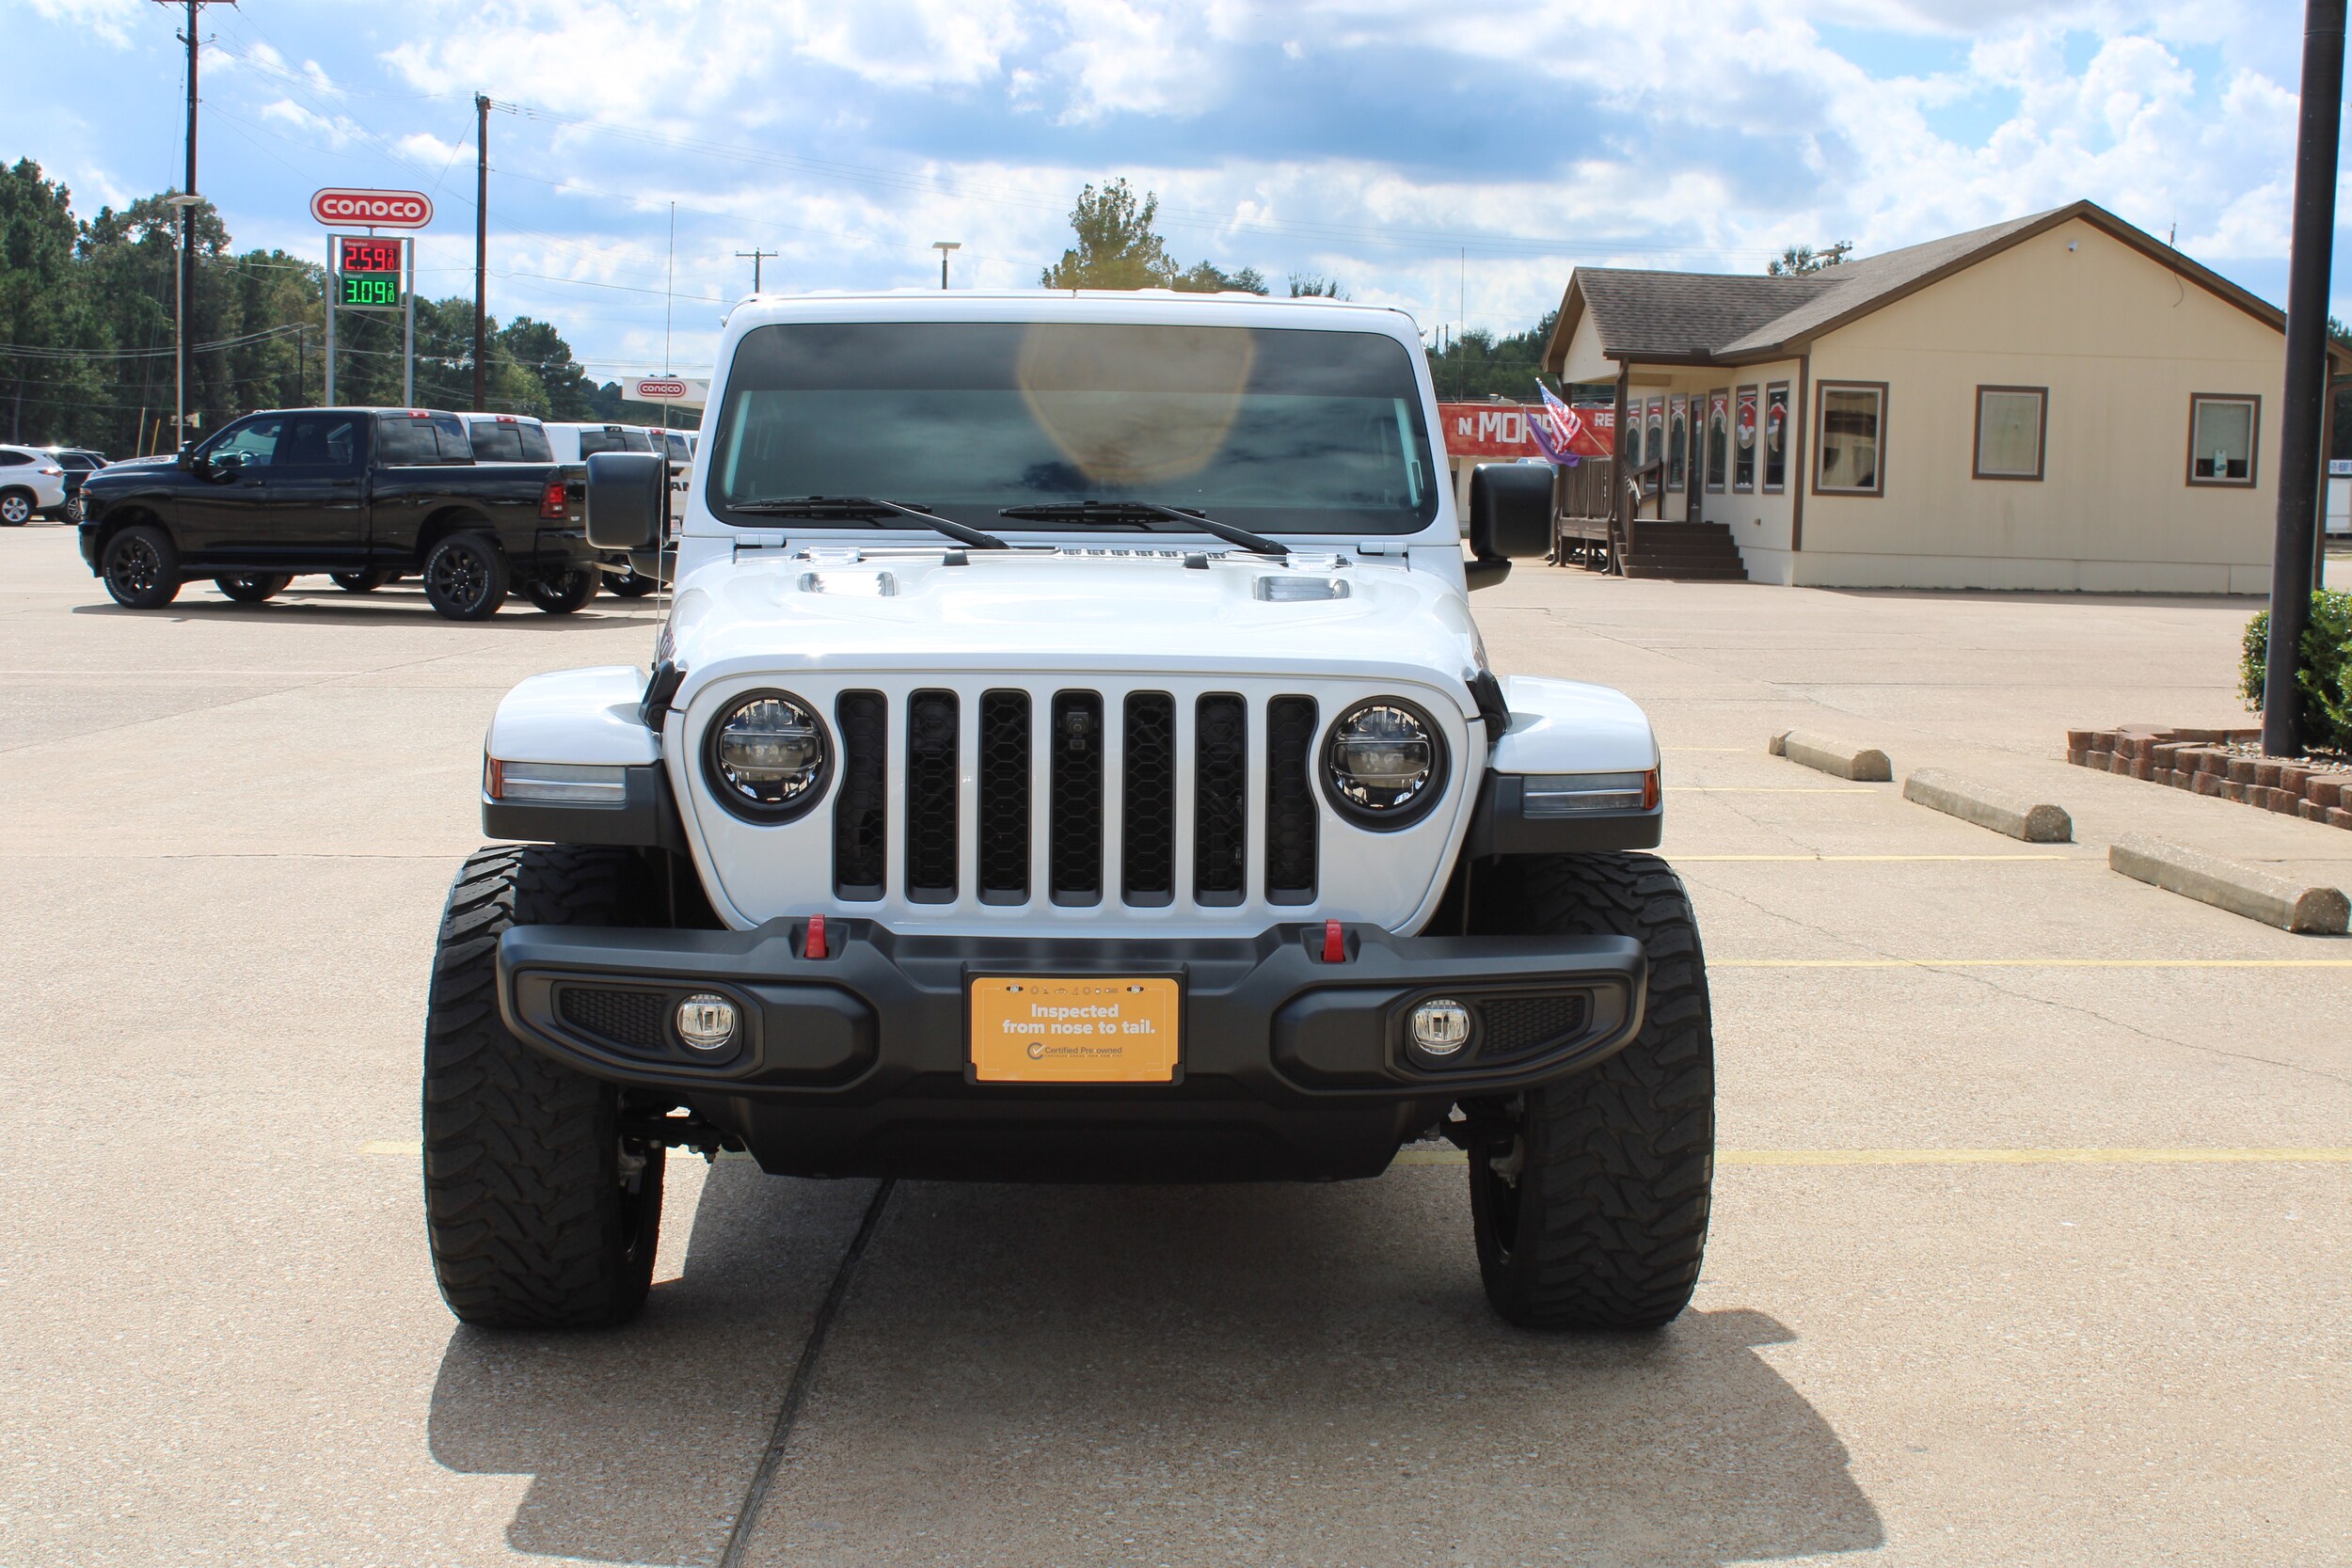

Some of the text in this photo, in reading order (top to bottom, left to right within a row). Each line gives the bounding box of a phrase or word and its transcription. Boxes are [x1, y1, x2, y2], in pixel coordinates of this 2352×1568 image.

[345, 247, 386, 271] 2.59
[346, 280, 386, 303] 3.09
[1031, 1004, 1119, 1021] Inspected
[1003, 1019, 1156, 1034] from nose to tail.
[1044, 1046, 1078, 1054] Certified
